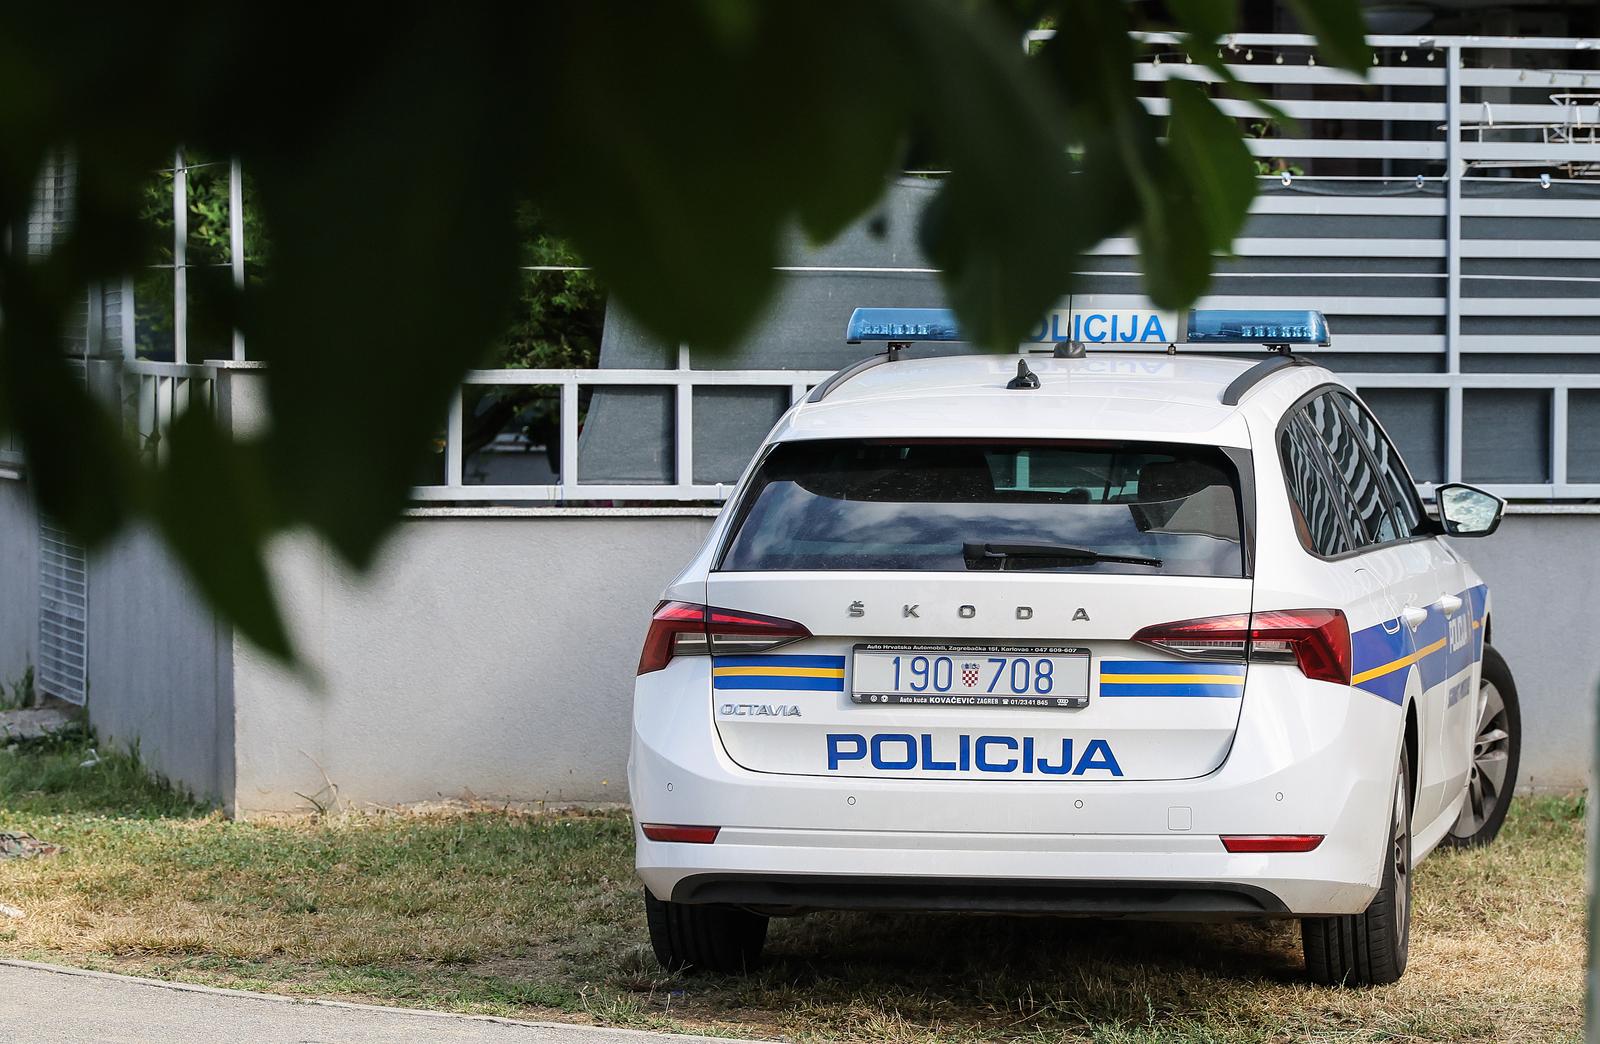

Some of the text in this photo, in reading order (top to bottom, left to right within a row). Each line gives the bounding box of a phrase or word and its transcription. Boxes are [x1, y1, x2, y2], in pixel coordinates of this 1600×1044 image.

[1026, 314, 1167, 343] OLICIJA
[849, 600, 1091, 622] ŠKODA
[892, 656, 1055, 695] 190 708
[720, 703, 802, 717] OCTAVIA
[929, 696, 975, 704] KOVAČEVIĆ
[976, 697, 999, 705] ZAGREB
[826, 733, 1124, 777] POLICIJA
